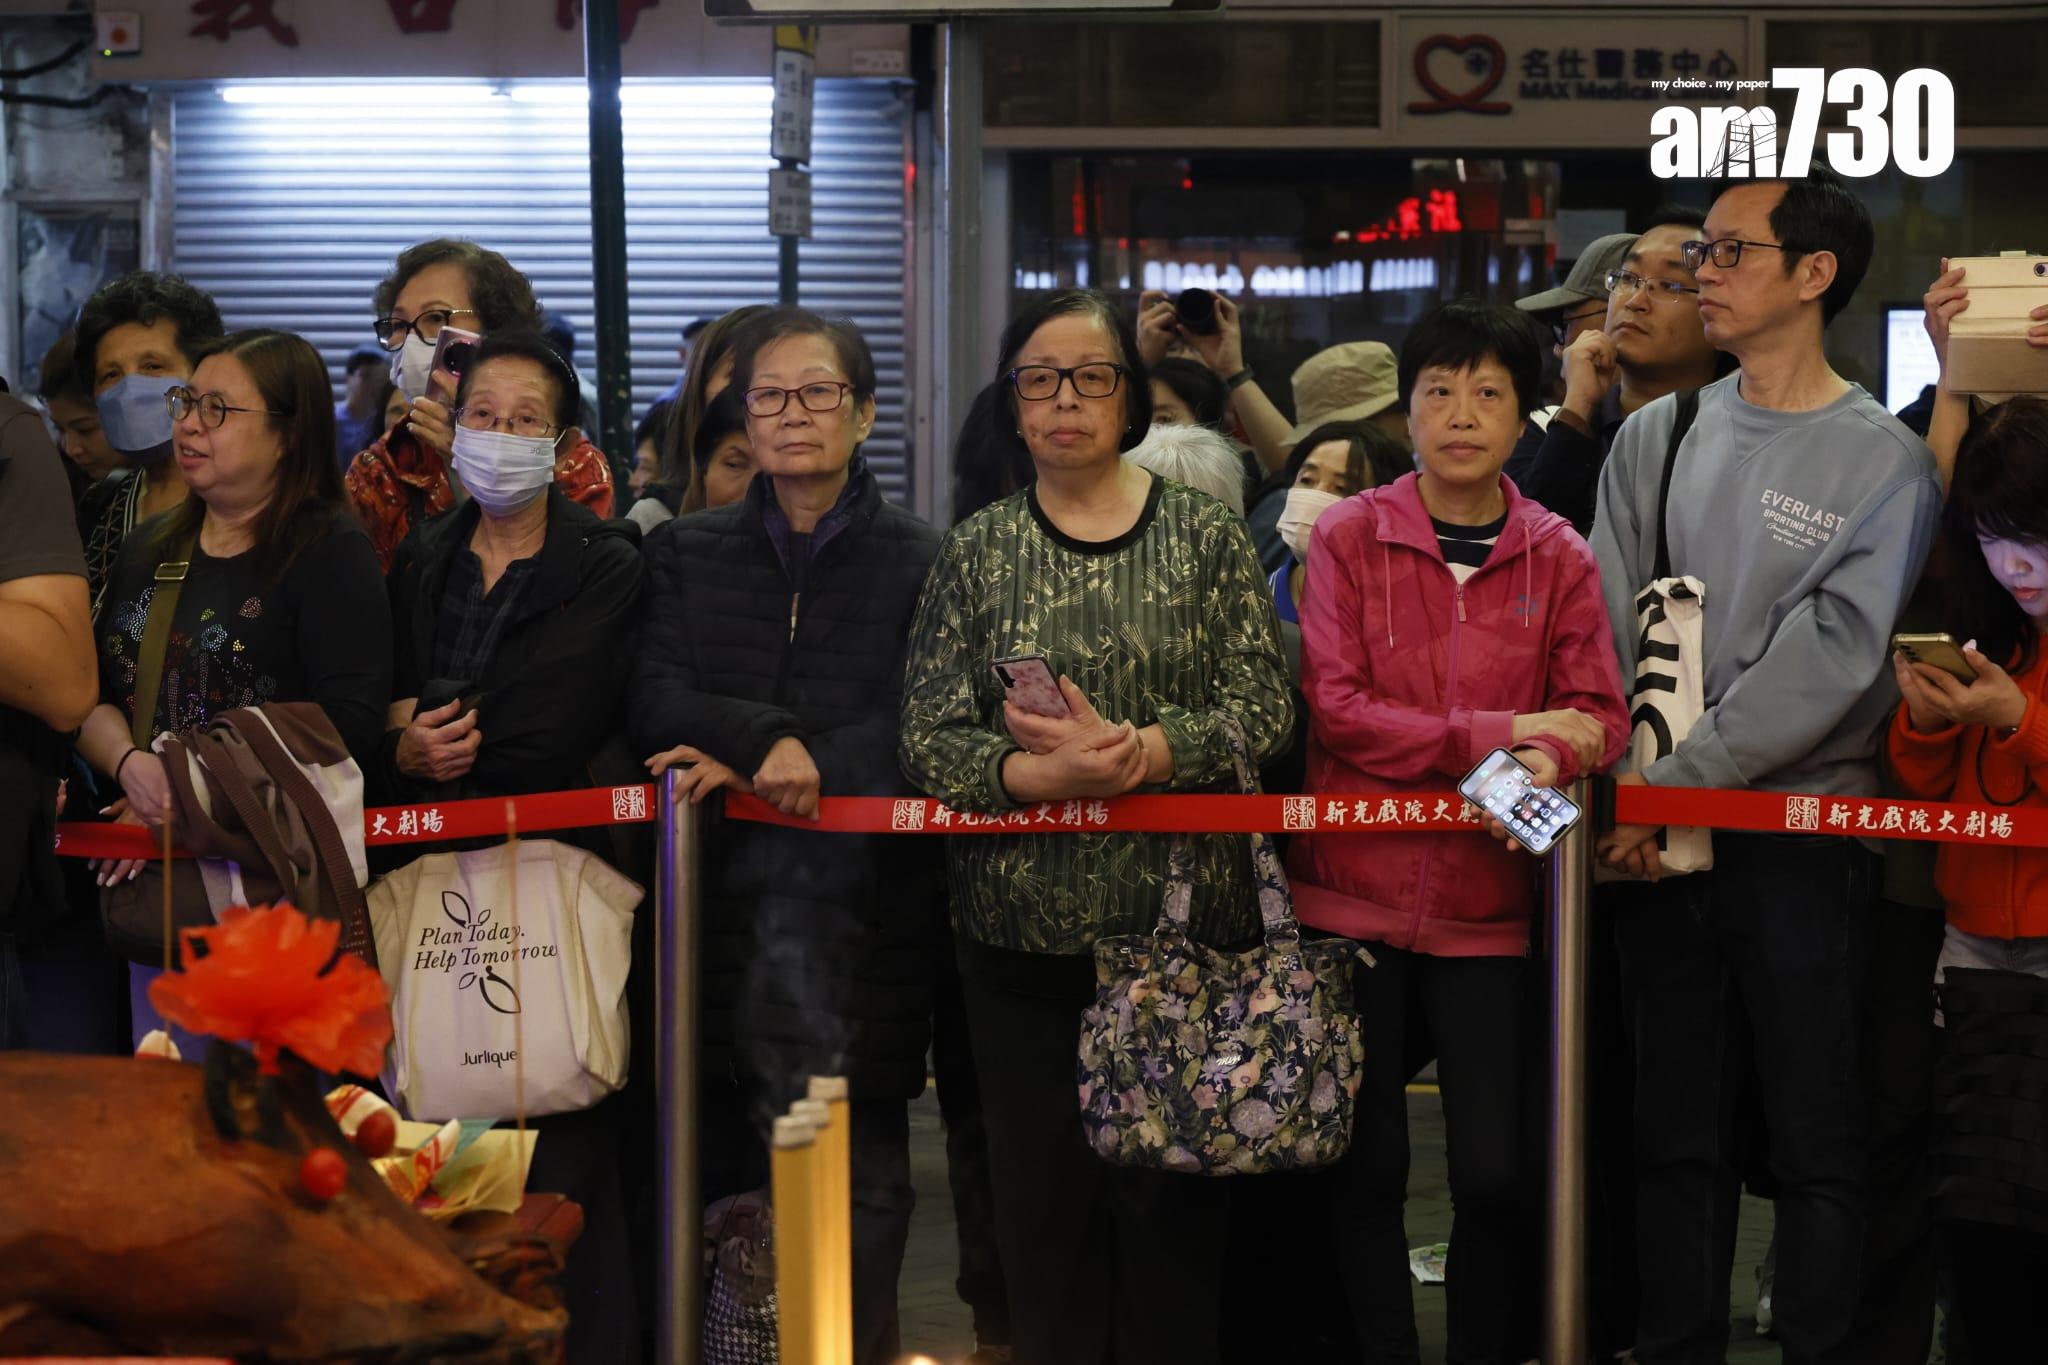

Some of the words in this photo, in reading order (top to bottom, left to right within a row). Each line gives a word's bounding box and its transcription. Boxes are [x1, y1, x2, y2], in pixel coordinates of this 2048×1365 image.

[1519, 81, 1569, 99] MAX
[1760, 489, 1846, 532] EVERLAST
[1763, 508, 1806, 531] SPORTING
[1806, 526, 1831, 542] CLUB
[371, 808, 444, 836] 大劇場
[1826, 802, 2014, 838] 新光戲院大劇場
[418, 926, 462, 946] Plan
[466, 922, 525, 945] Today.
[413, 949, 457, 973] Help
[461, 944, 558, 966] Tomorrow
[460, 1050, 518, 1068] Jurlique
